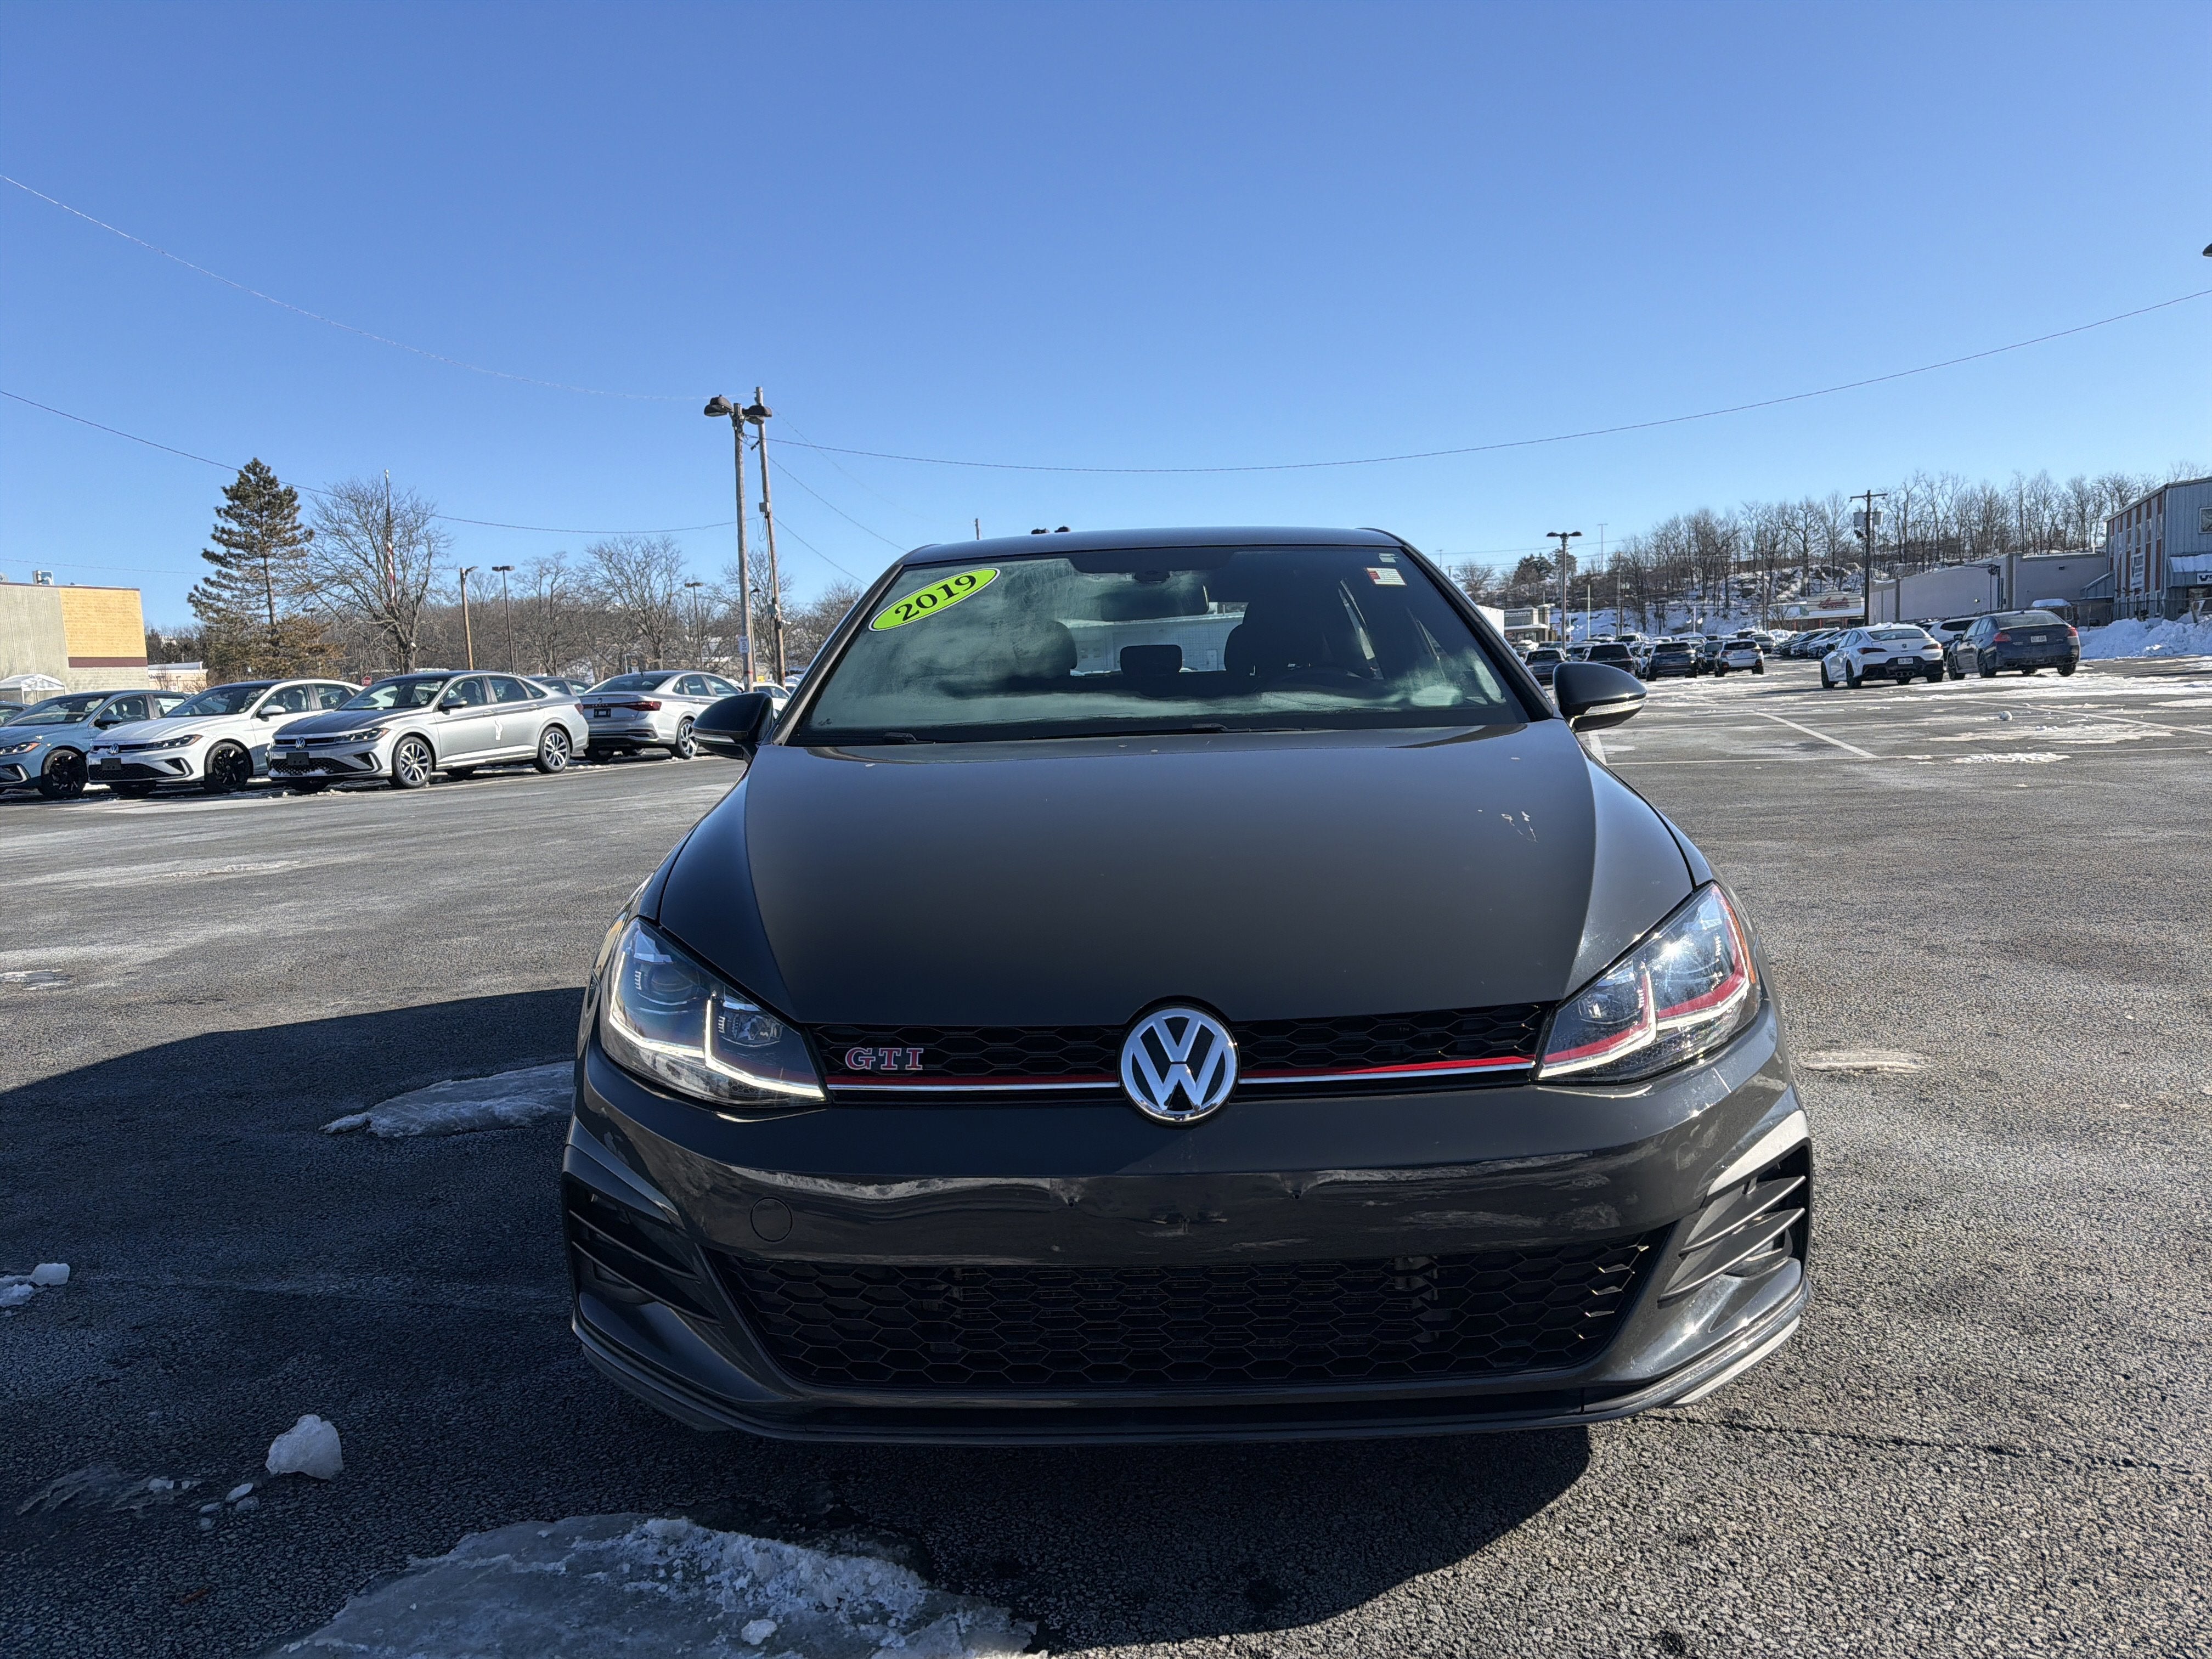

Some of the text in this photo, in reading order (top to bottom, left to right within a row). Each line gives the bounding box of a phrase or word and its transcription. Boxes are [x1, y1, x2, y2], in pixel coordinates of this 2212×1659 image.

[894, 575, 977, 622] 2019
[845, 1047, 924, 1070] GTI
[1122, 1009, 1237, 1120] VW
